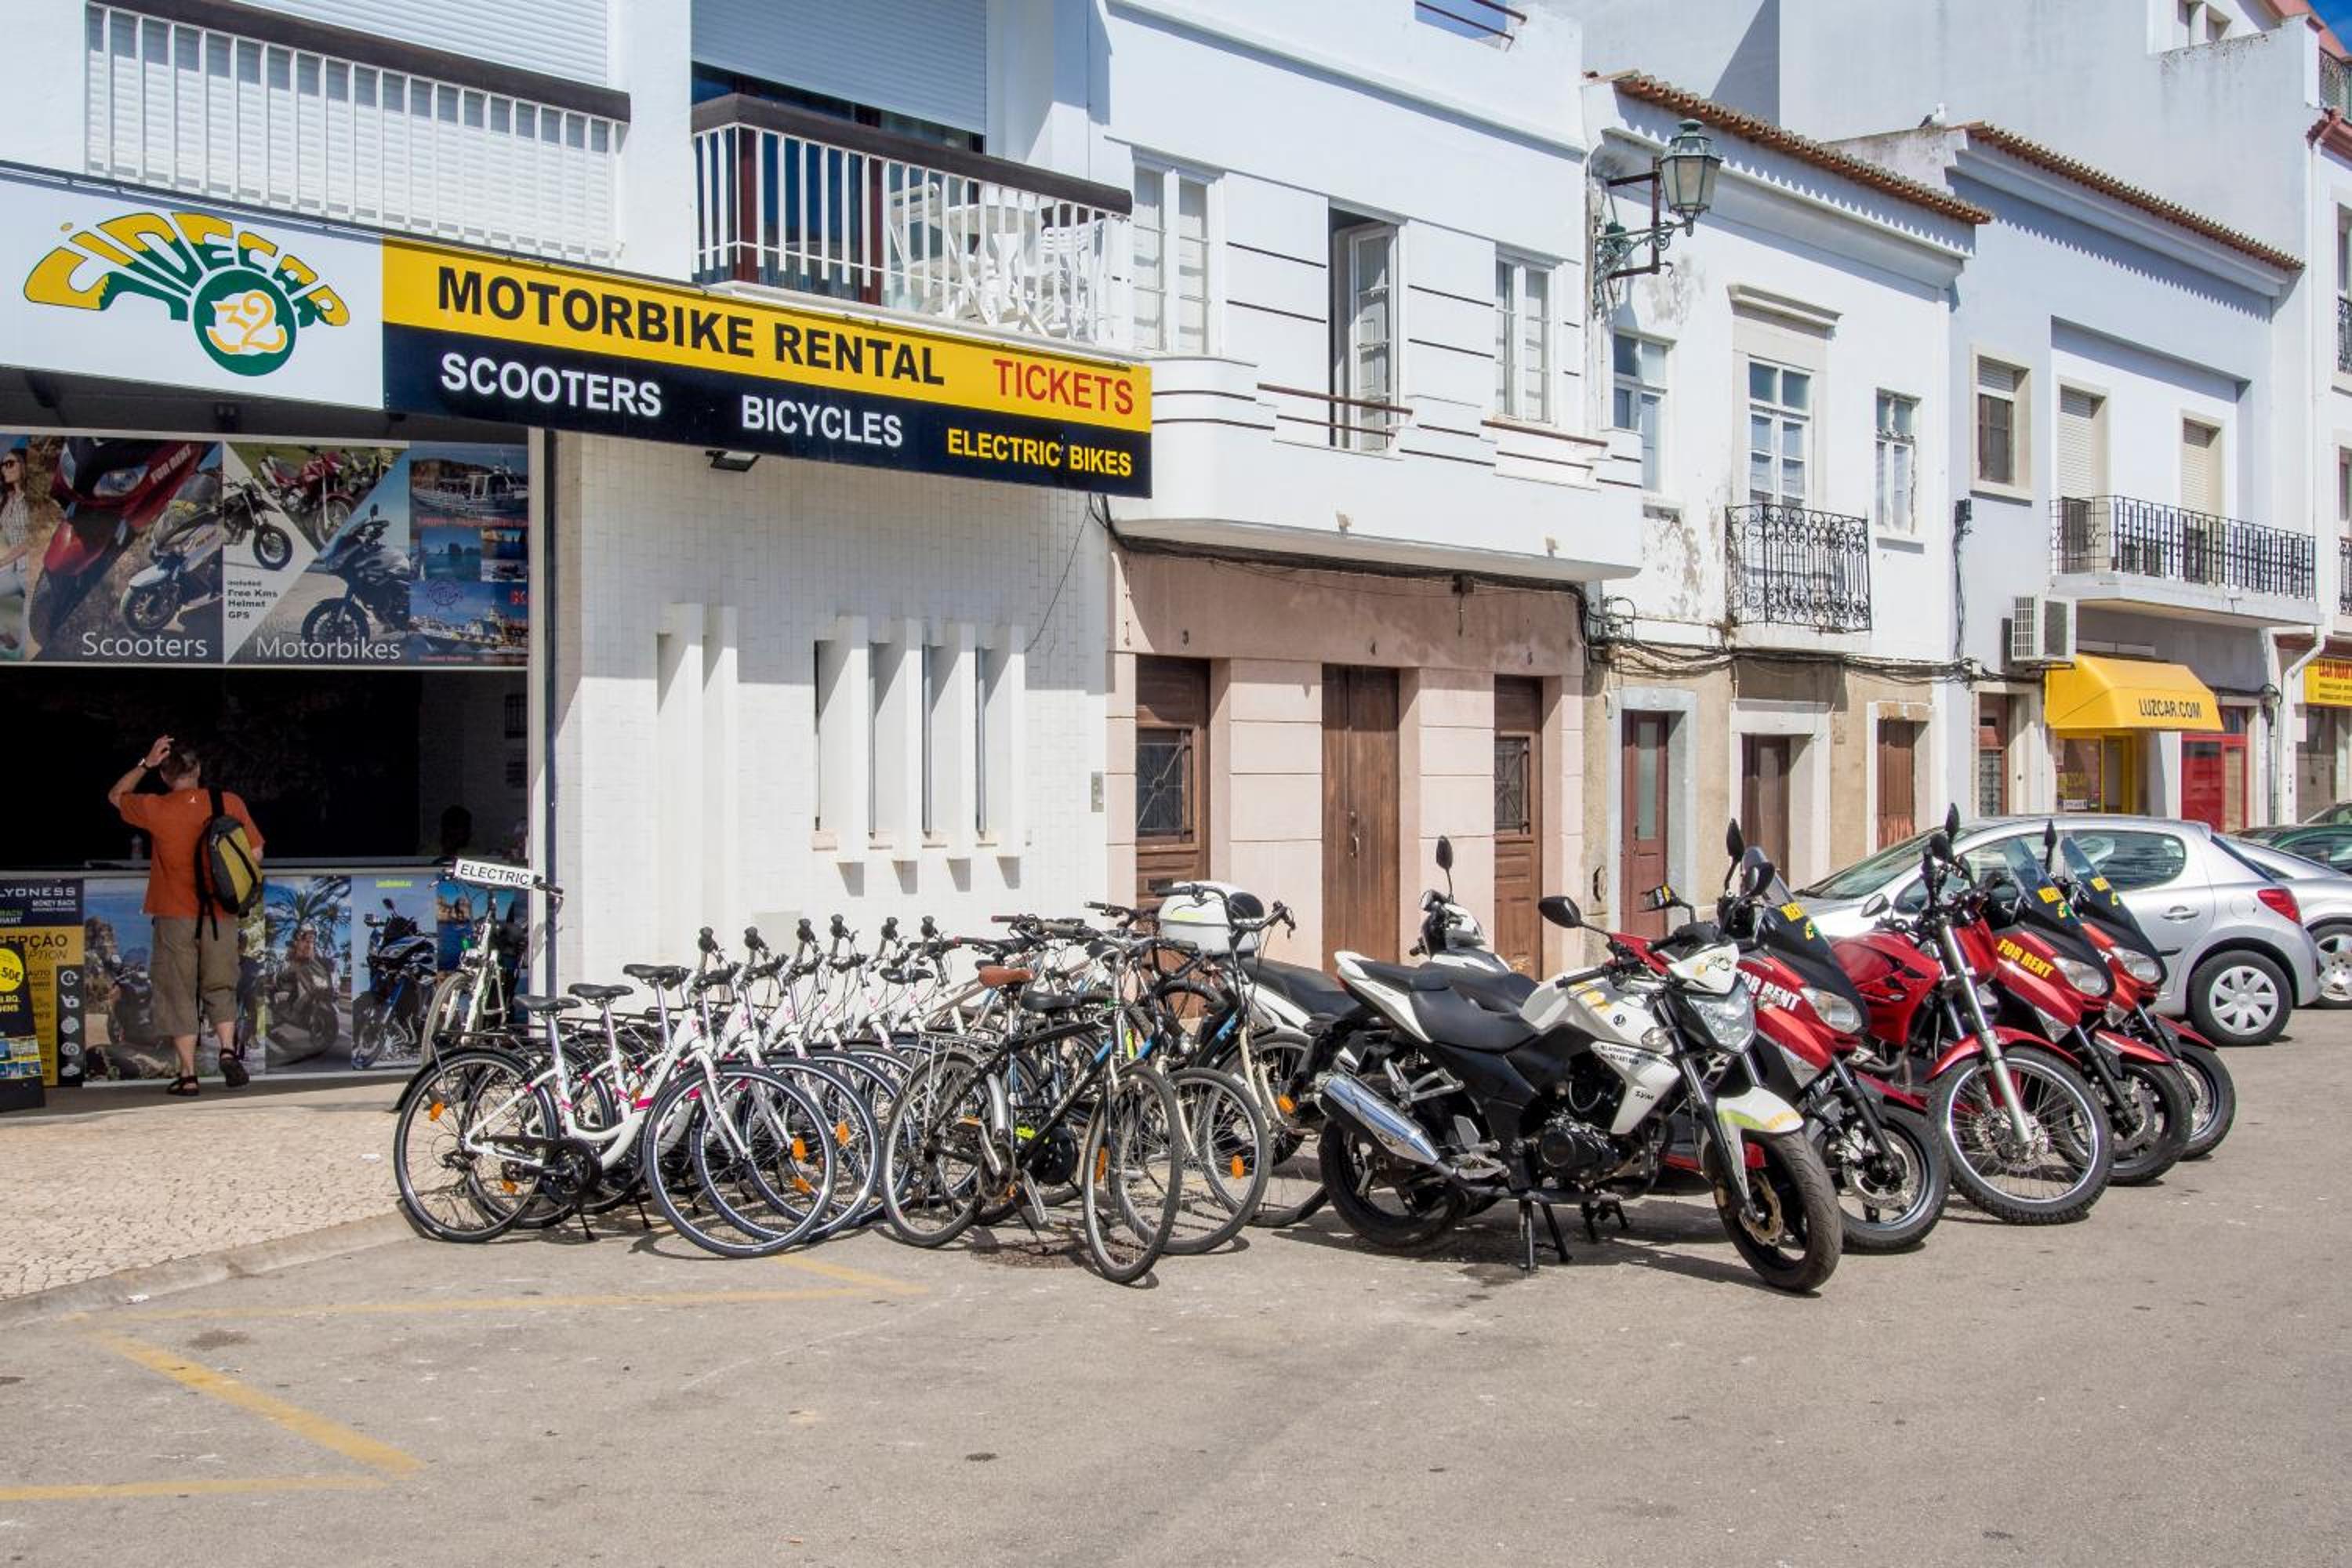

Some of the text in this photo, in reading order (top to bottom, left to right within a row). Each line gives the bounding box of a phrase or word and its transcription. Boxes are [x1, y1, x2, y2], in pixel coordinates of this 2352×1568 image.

[438, 266, 945, 386] MOTORBIKE RENTAL
[441, 352, 662, 417] SCOOTERS
[993, 358, 1134, 416] TICKETS
[742, 394, 903, 448] BICYCLES
[947, 427, 1133, 477] ELECTRIC BIKES
[82, 632, 209, 657] Scooters
[256, 636, 401, 660] Motorbikes
[2138, 698, 2202, 719] LUZCAR.COM
[459, 863, 530, 885] ELECTRIC
[1997, 938, 2055, 978] FOR RENT
[1735, 967, 1802, 1011] OR RENT
